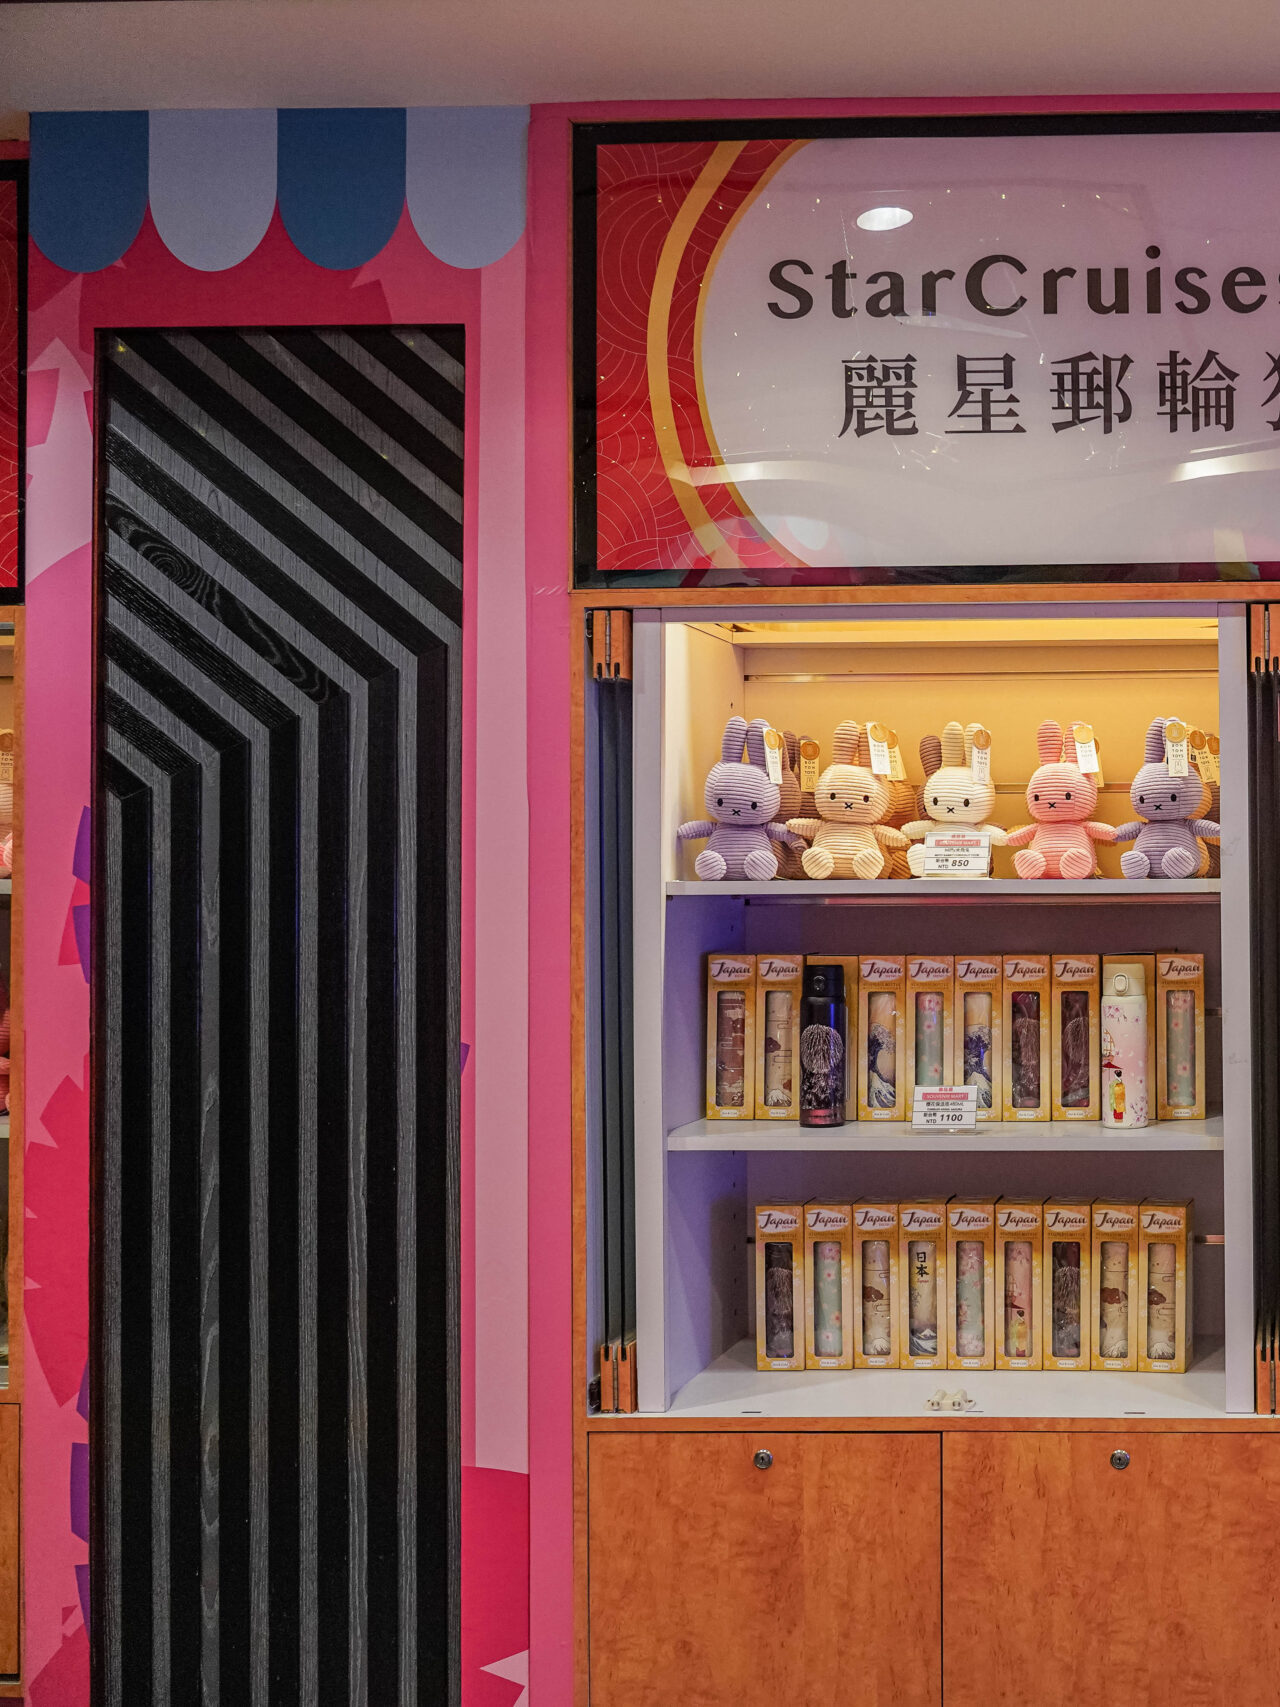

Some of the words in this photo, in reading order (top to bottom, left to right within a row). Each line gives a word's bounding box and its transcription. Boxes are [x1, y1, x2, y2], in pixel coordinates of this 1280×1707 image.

[712, 962, 751, 977] Japan
[760, 961, 799, 977] Japan
[861, 962, 902, 978] Japan
[911, 962, 950, 978] Japan
[958, 962, 998, 978] Japan
[1006, 962, 1046, 978] Japan
[1056, 962, 1096, 978] Japan
[1160, 960, 1200, 976] Japan
[758, 1213, 798, 1229] Japan
[808, 1212, 847, 1227] Japan
[856, 1211, 895, 1226] Japan
[902, 1212, 942, 1227] Japan
[951, 1211, 990, 1226] Japan
[999, 1212, 1039, 1227] Japan
[1046, 1212, 1086, 1227] Japan
[1096, 1212, 1134, 1227] Japan
[1142, 1213, 1182, 1228] Japan
[916, 1252, 929, 1277] 日本
